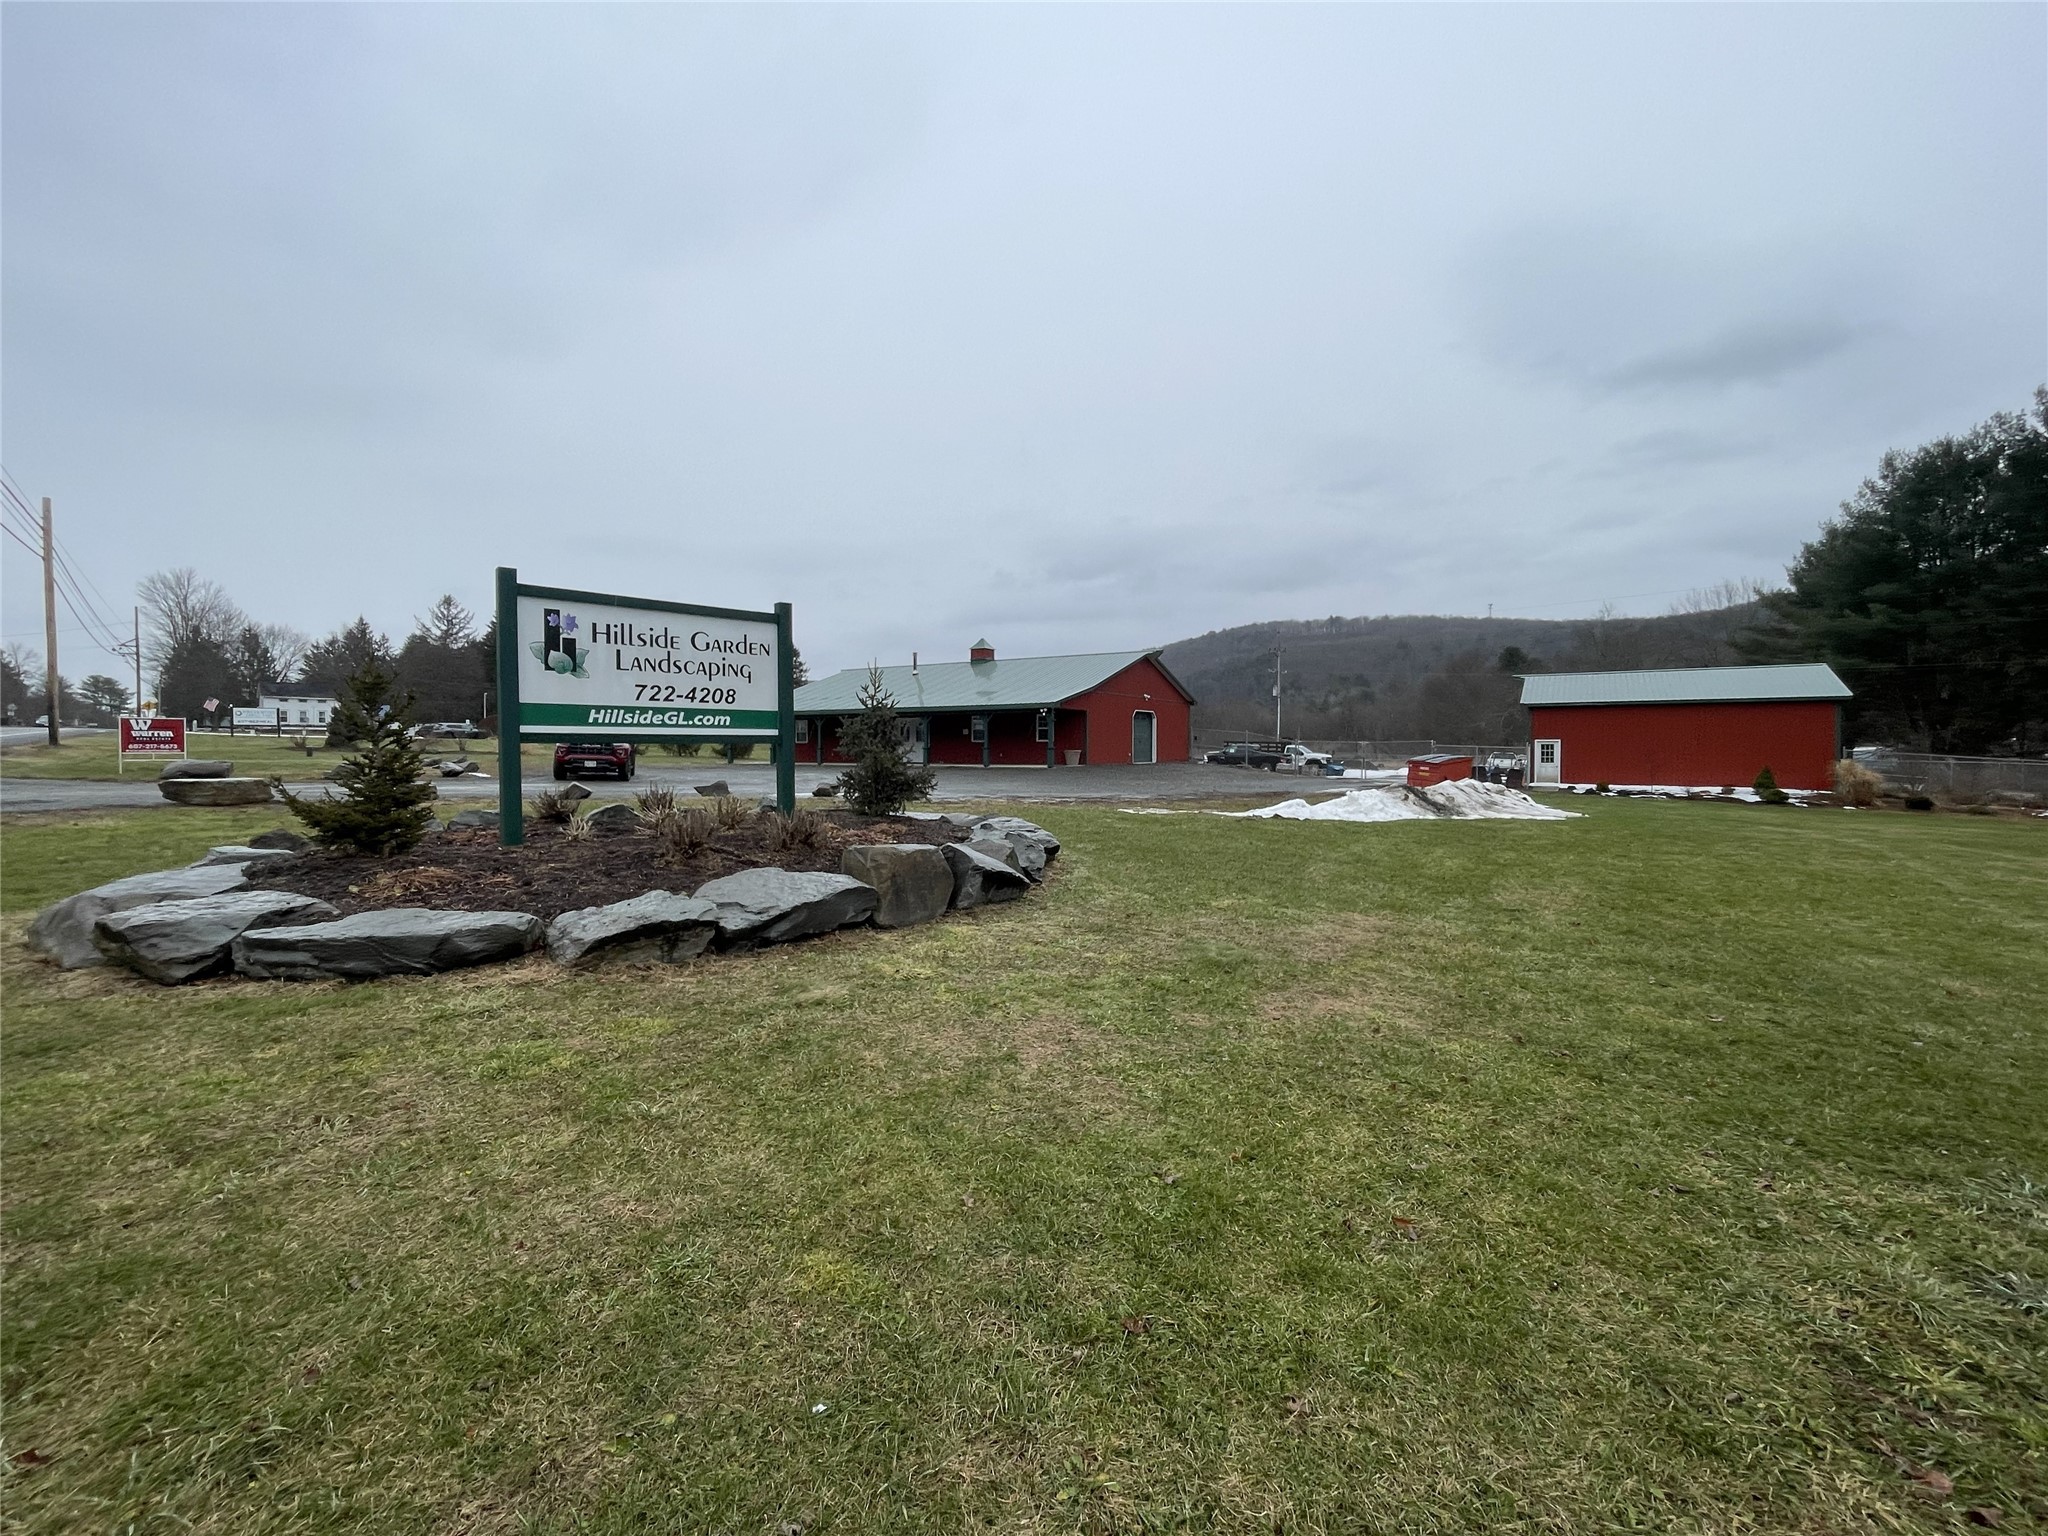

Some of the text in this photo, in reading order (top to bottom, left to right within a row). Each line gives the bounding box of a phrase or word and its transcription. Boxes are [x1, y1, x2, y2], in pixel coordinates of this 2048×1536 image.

[592, 622, 771, 657] Hillside Garden
[616, 649, 752, 684] Landscaping
[634, 684, 737, 705] 722-4208
[588, 708, 731, 726] HillsideGL.com
